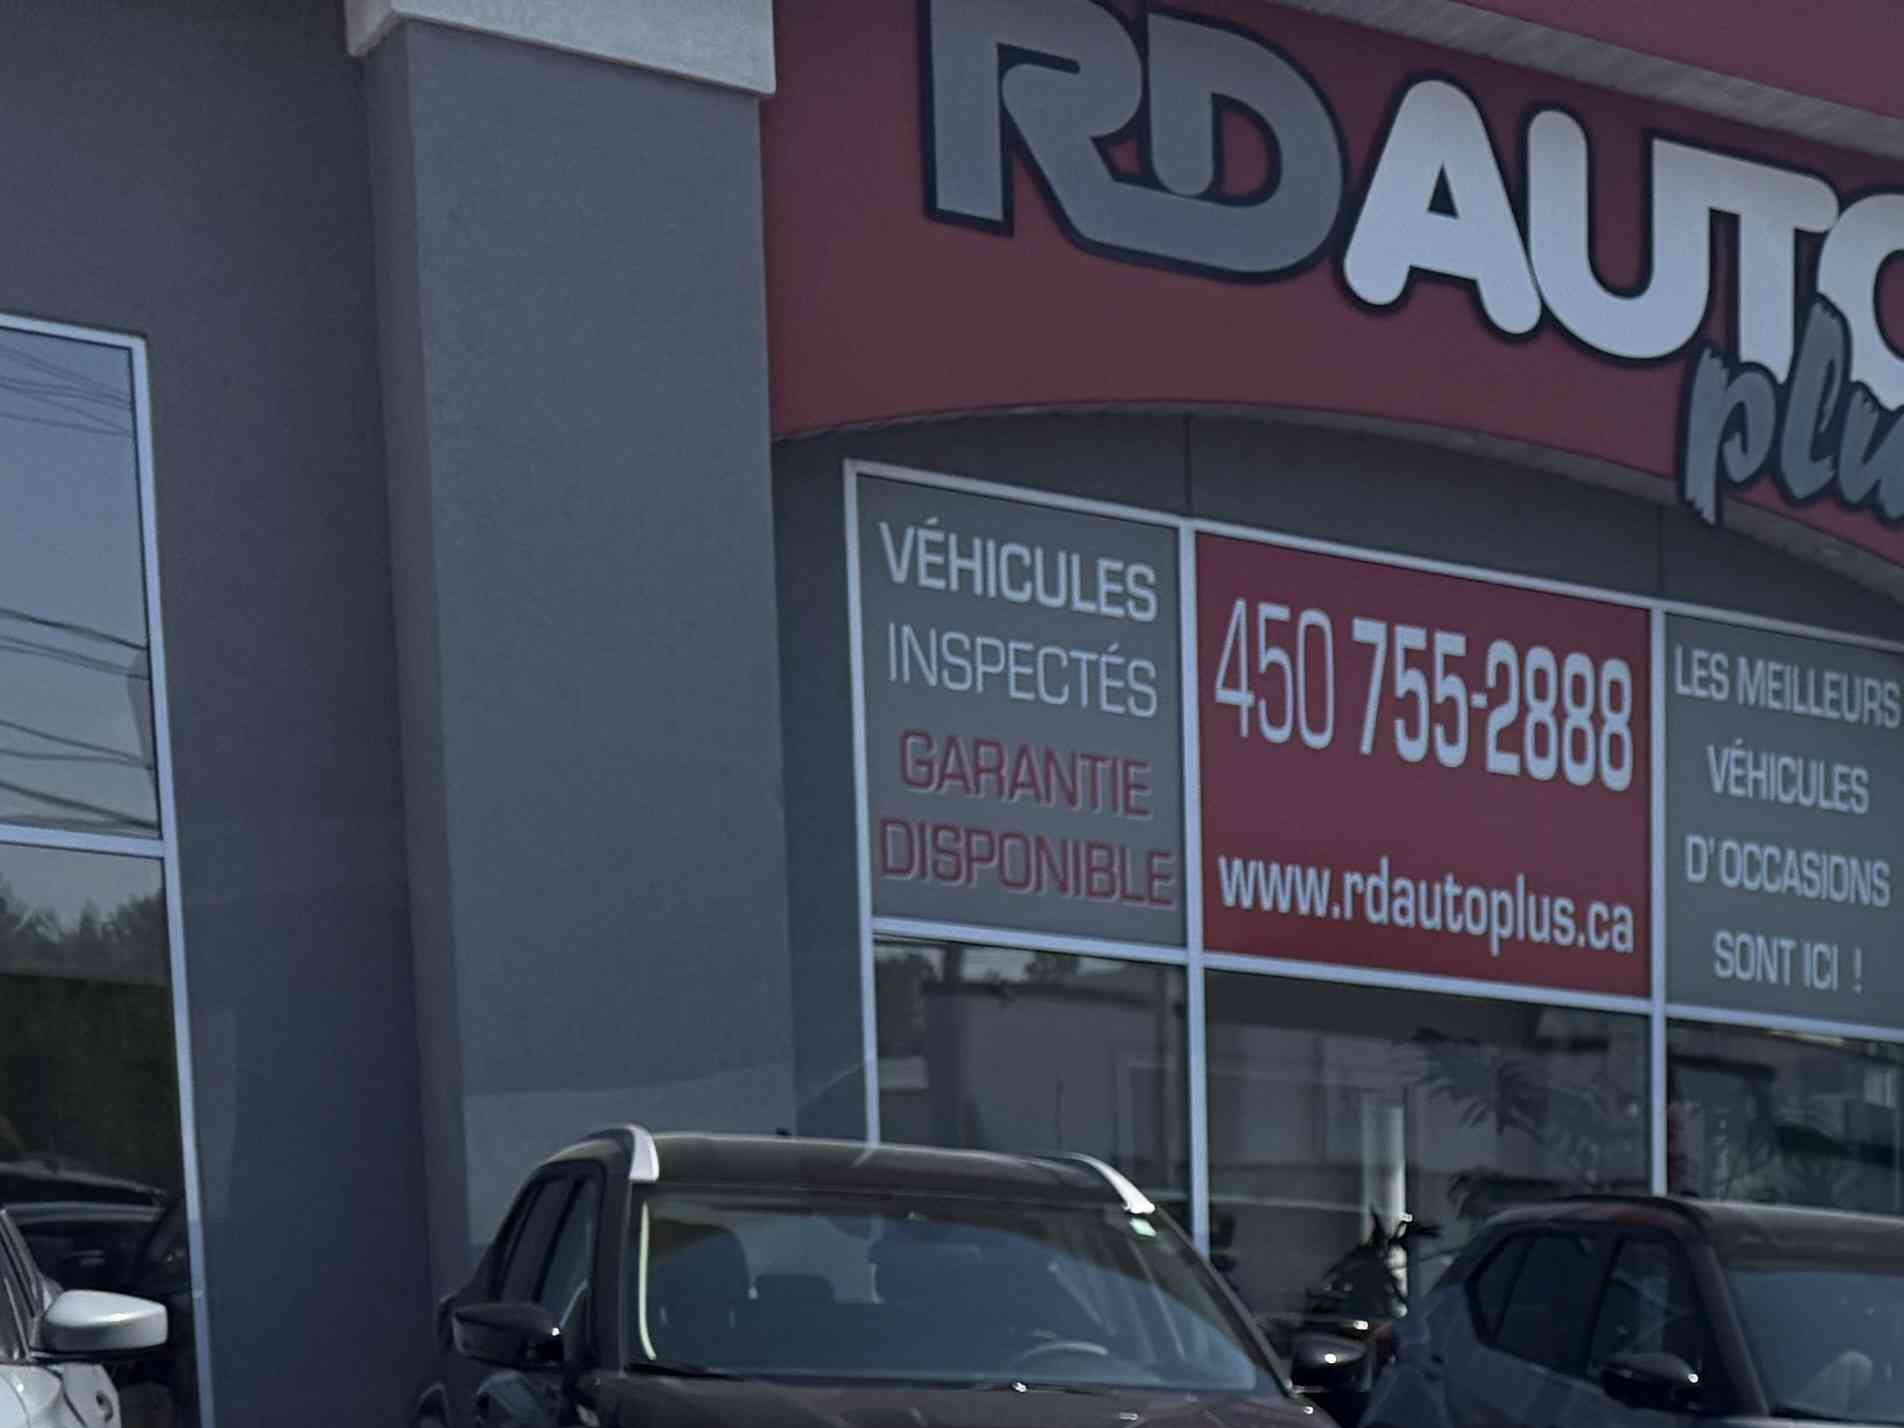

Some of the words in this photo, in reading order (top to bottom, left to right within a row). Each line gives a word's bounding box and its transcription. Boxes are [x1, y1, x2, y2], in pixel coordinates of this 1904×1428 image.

[879, 516, 1158, 623] VÉHICULES
[887, 621, 1158, 719] INSPECTÉS
[1215, 597, 1335, 750] 450
[1352, 616, 1633, 792] 755-2888
[1674, 644, 1729, 700] LES
[1737, 656, 1901, 728] MEILLEURS
[899, 728, 1153, 821] GARANTIE
[1706, 738, 1869, 814] VÉHICULES
[880, 817, 1176, 910] DISPONIBLE
[1217, 855, 1634, 957] www.rdautoplus.ca
[1714, 929, 1797, 986] SONT
[1804, 940, 1839, 992] ICI
